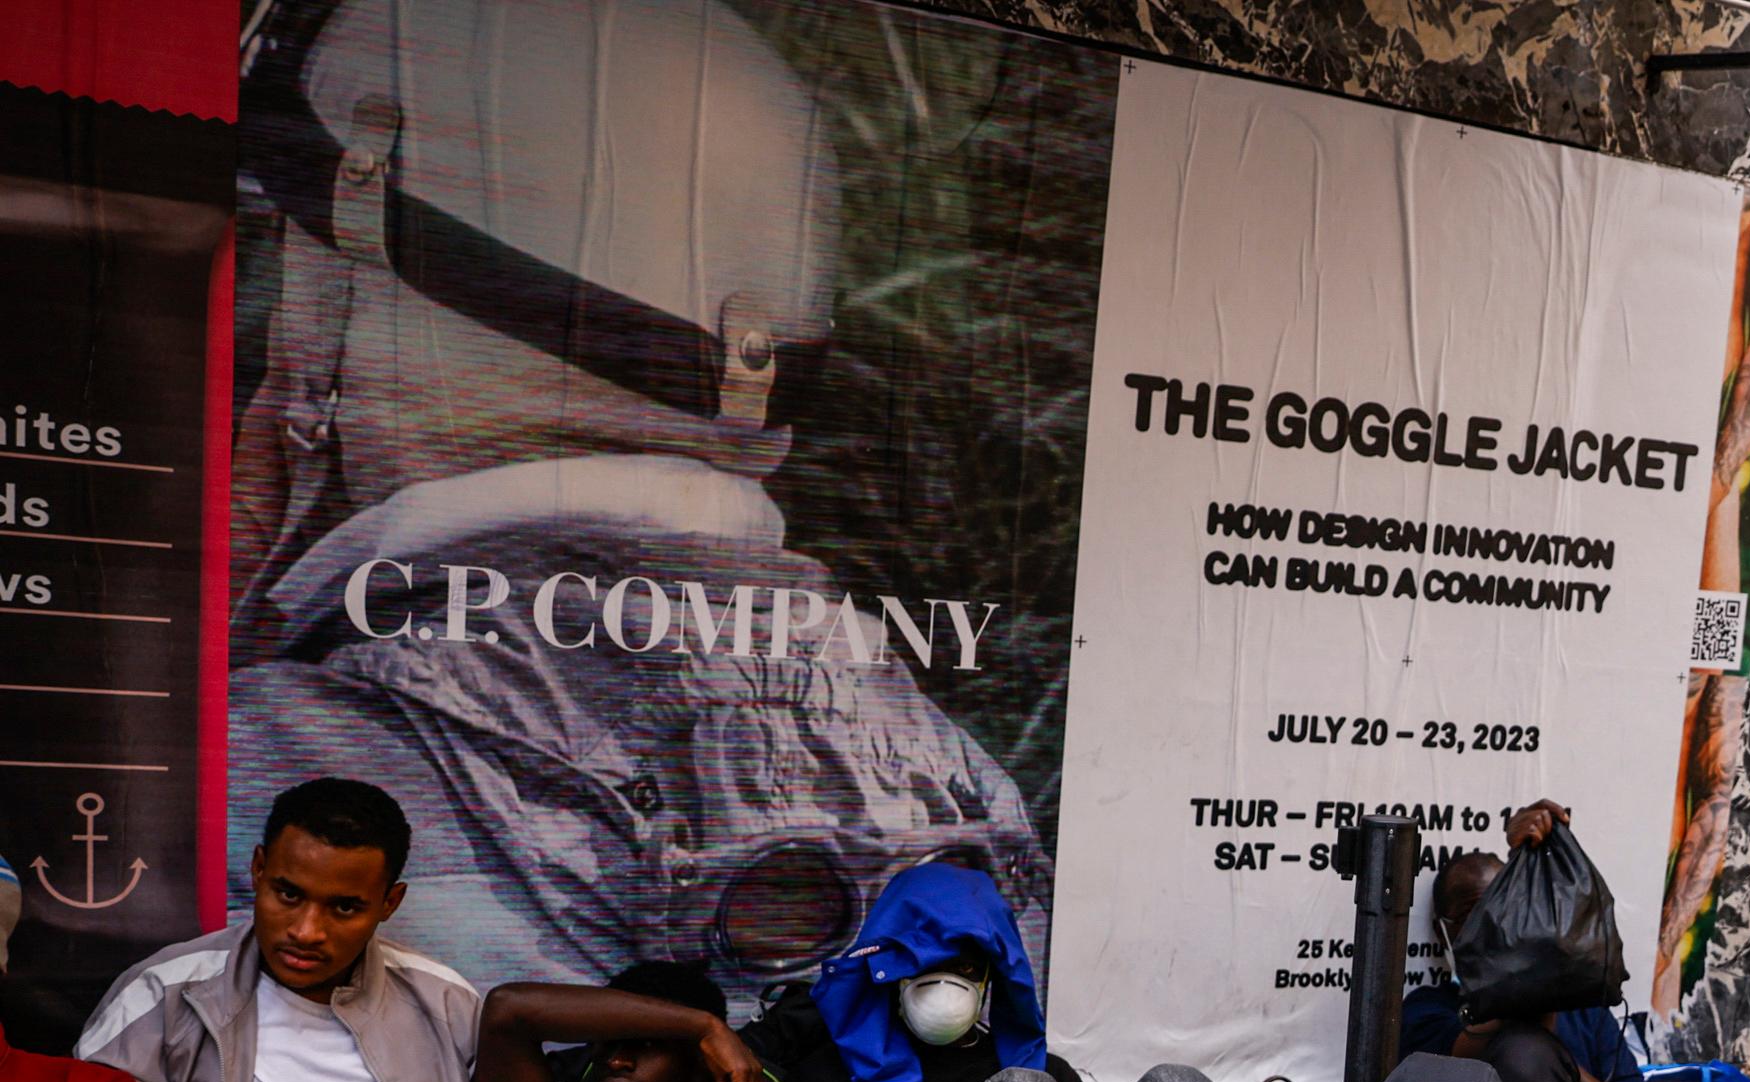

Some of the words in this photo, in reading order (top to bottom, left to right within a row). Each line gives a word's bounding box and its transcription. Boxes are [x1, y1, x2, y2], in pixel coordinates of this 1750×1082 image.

[0, 405, 122, 457] ites
[1124, 373, 1254, 444] THE
[1264, 390, 1502, 471] GOGGLE
[1507, 423, 1699, 492] JACKET
[1207, 502, 1292, 541] HOW
[1298, 510, 1428, 554] DESIGN
[1433, 524, 1615, 569] INNOVATION
[1204, 551, 1279, 588] CAN
[1285, 558, 1389, 597] BUILD
[1393, 568, 1418, 600] A
[1423, 570, 1611, 614] COMMUNITY
[345, 558, 511, 644] C.P.
[533, 571, 1000, 671] COMPANY
[1268, 714, 1345, 744] JULY
[1351, 718, 1388, 746] 20
[1422, 722, 1465, 754] 23,
[1473, 724, 1540, 753] 2023
[1190, 798, 1278, 828] THUR
[1315, 801, 1364, 828] FRI
[1460, 806, 1490, 832] to
[1214, 842, 1275, 871] SAT
[1297, 939, 1324, 959] 25
[1275, 969, 1351, 991] Brookly
